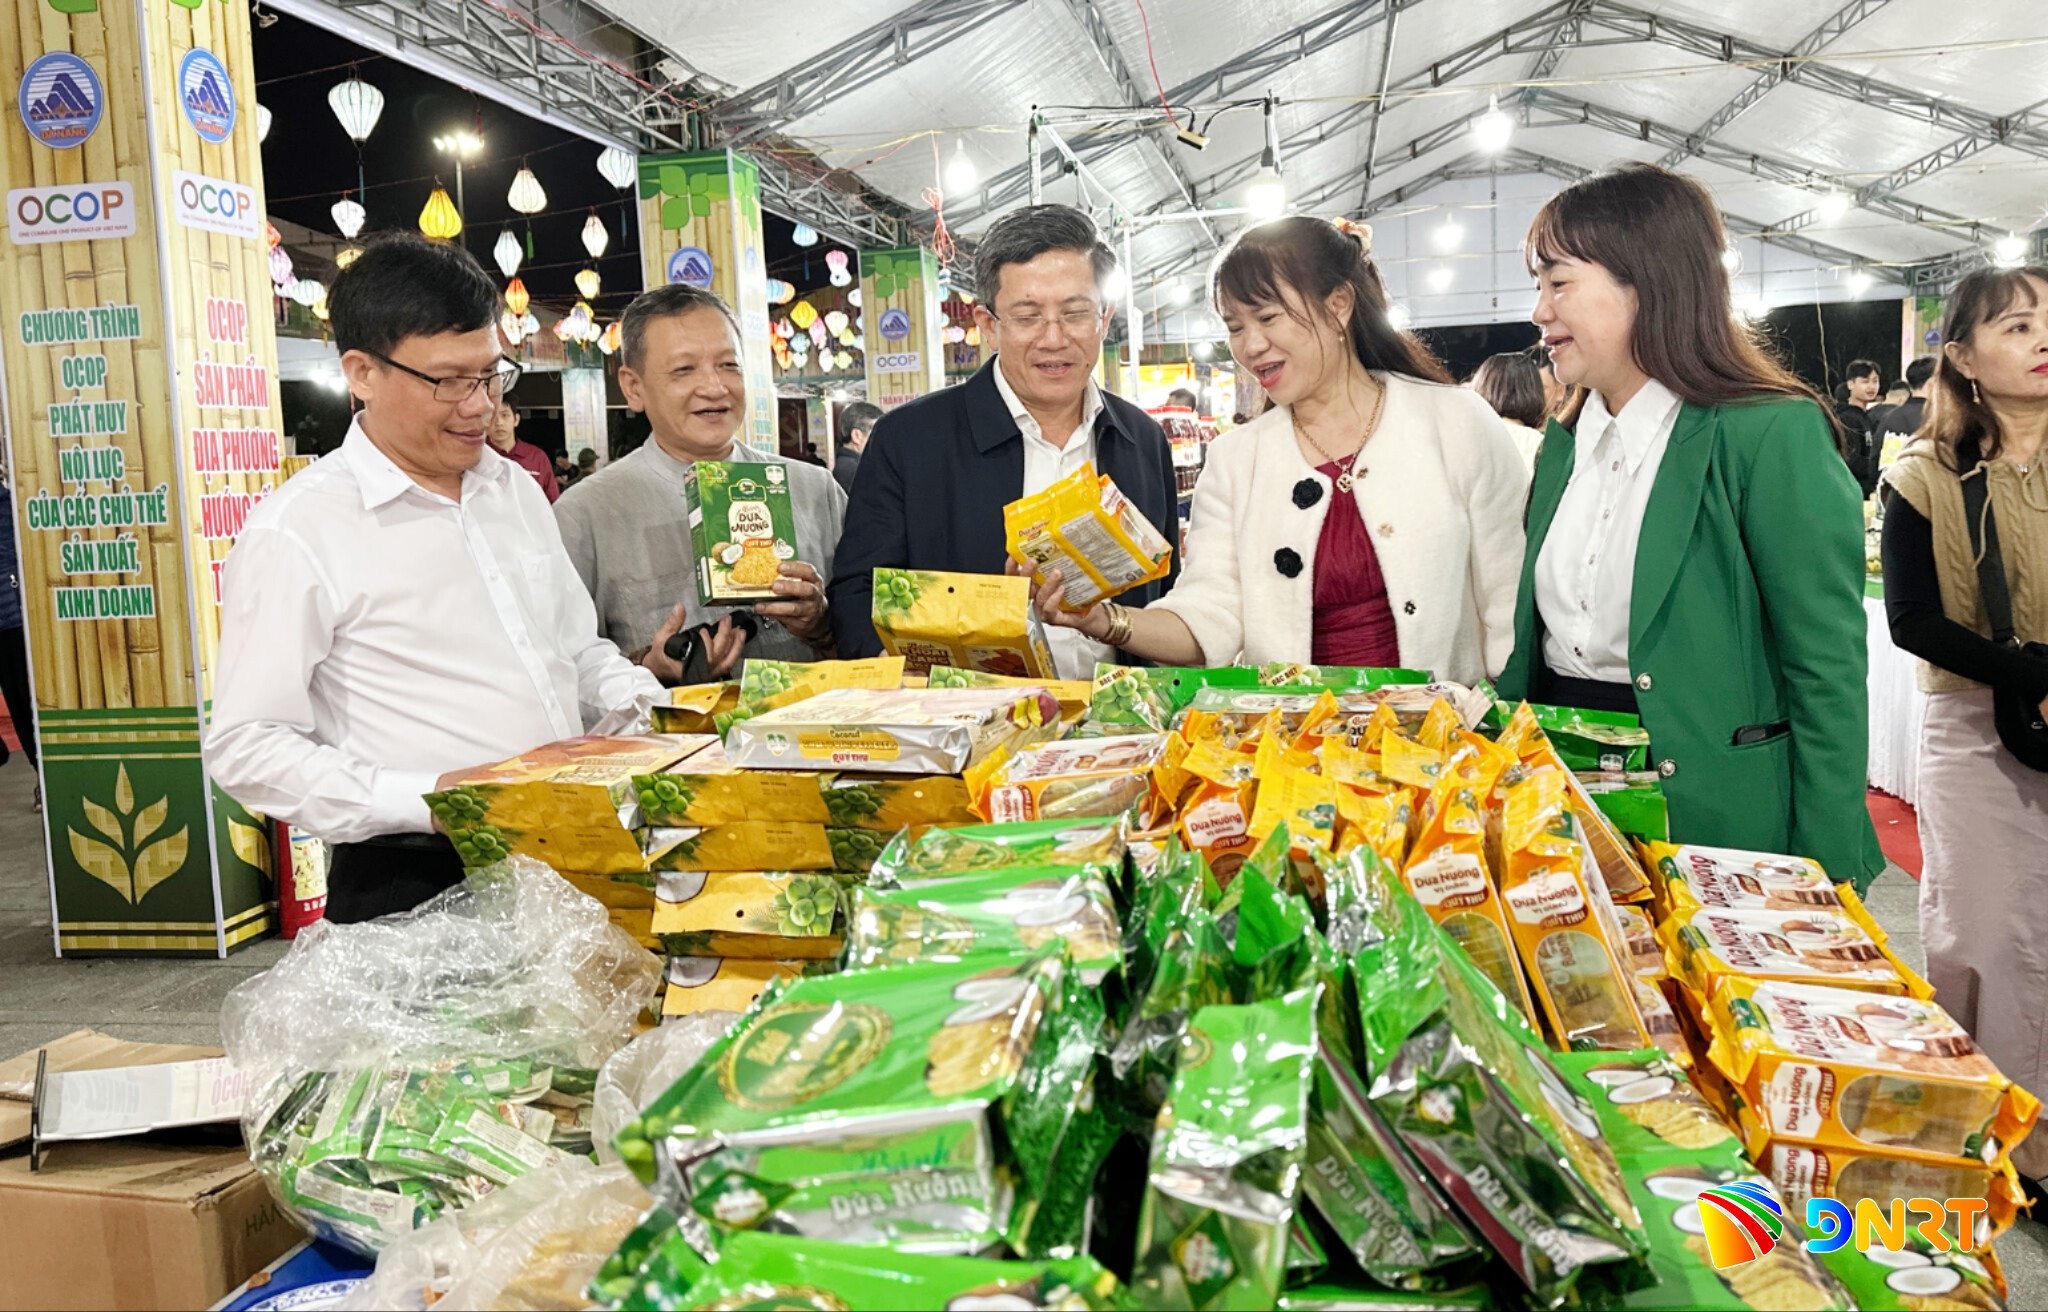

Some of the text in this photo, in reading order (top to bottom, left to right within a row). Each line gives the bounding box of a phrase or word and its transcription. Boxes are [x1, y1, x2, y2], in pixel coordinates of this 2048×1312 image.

[18, 190, 124, 226] OCOP
[181, 180, 250, 218] OCOP
[21, 303, 140, 343] CHƯƠNG TRÌNH
[207, 299, 246, 342] OCOP
[62, 357, 106, 387] OCOP
[194, 352, 268, 407] SẢN PHẨM
[877, 355, 916, 367] OCOP
[50, 399, 126, 435] PHÁT HUY
[61, 447, 123, 486] NỘI LỰC
[193, 429, 279, 482] ĐỊA PHƯƠNG
[28, 484, 167, 528] CỦA CÁC CHỦ THỂ
[61, 534, 140, 574] SẢN XUẤT,
[57, 587, 153, 618] KINH DOANH
